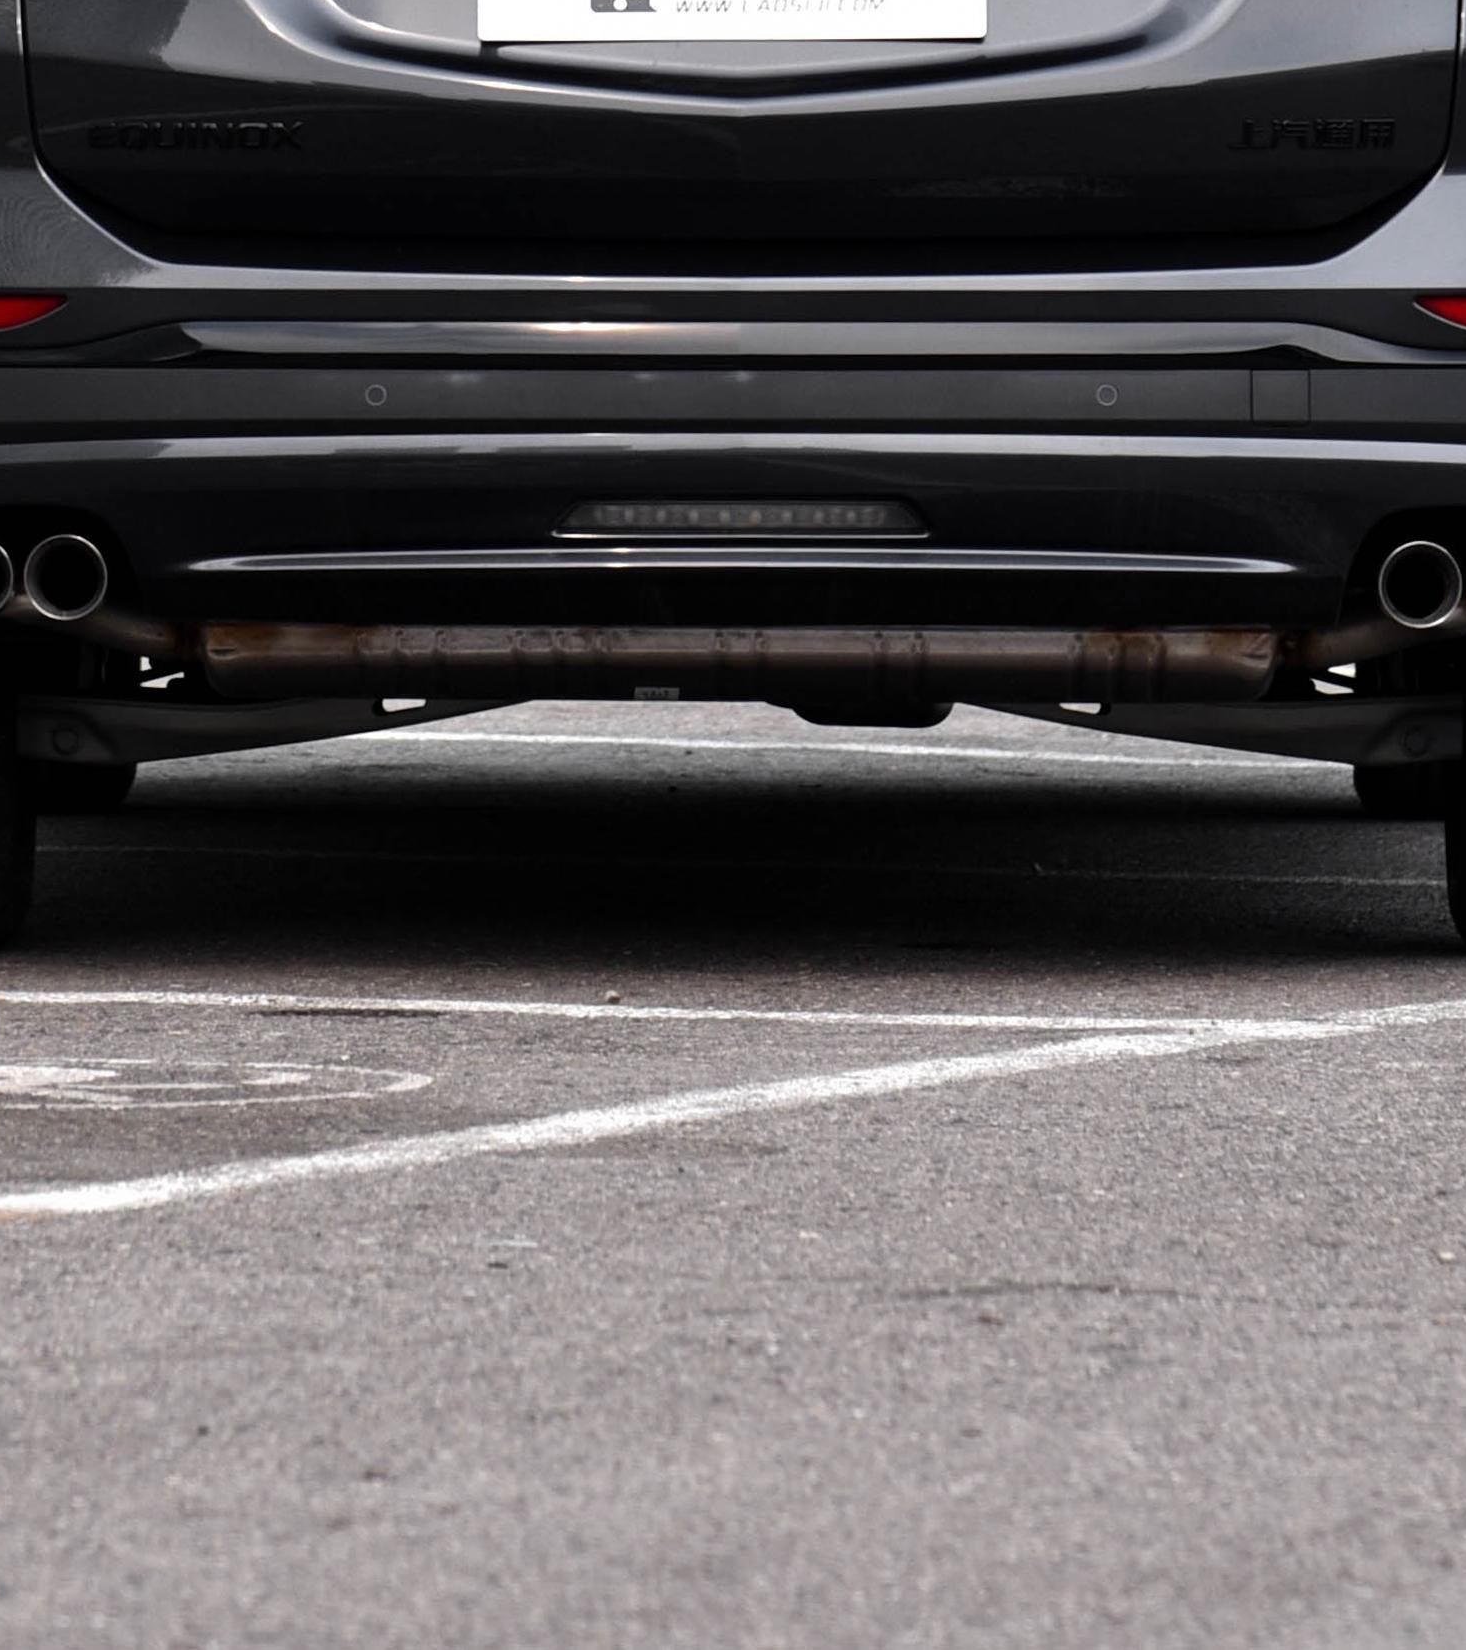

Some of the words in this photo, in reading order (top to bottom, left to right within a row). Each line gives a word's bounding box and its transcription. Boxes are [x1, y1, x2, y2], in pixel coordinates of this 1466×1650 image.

[87, 120, 304, 151] EQUINOX
[1227, 118, 1396, 150] 上汽通用
